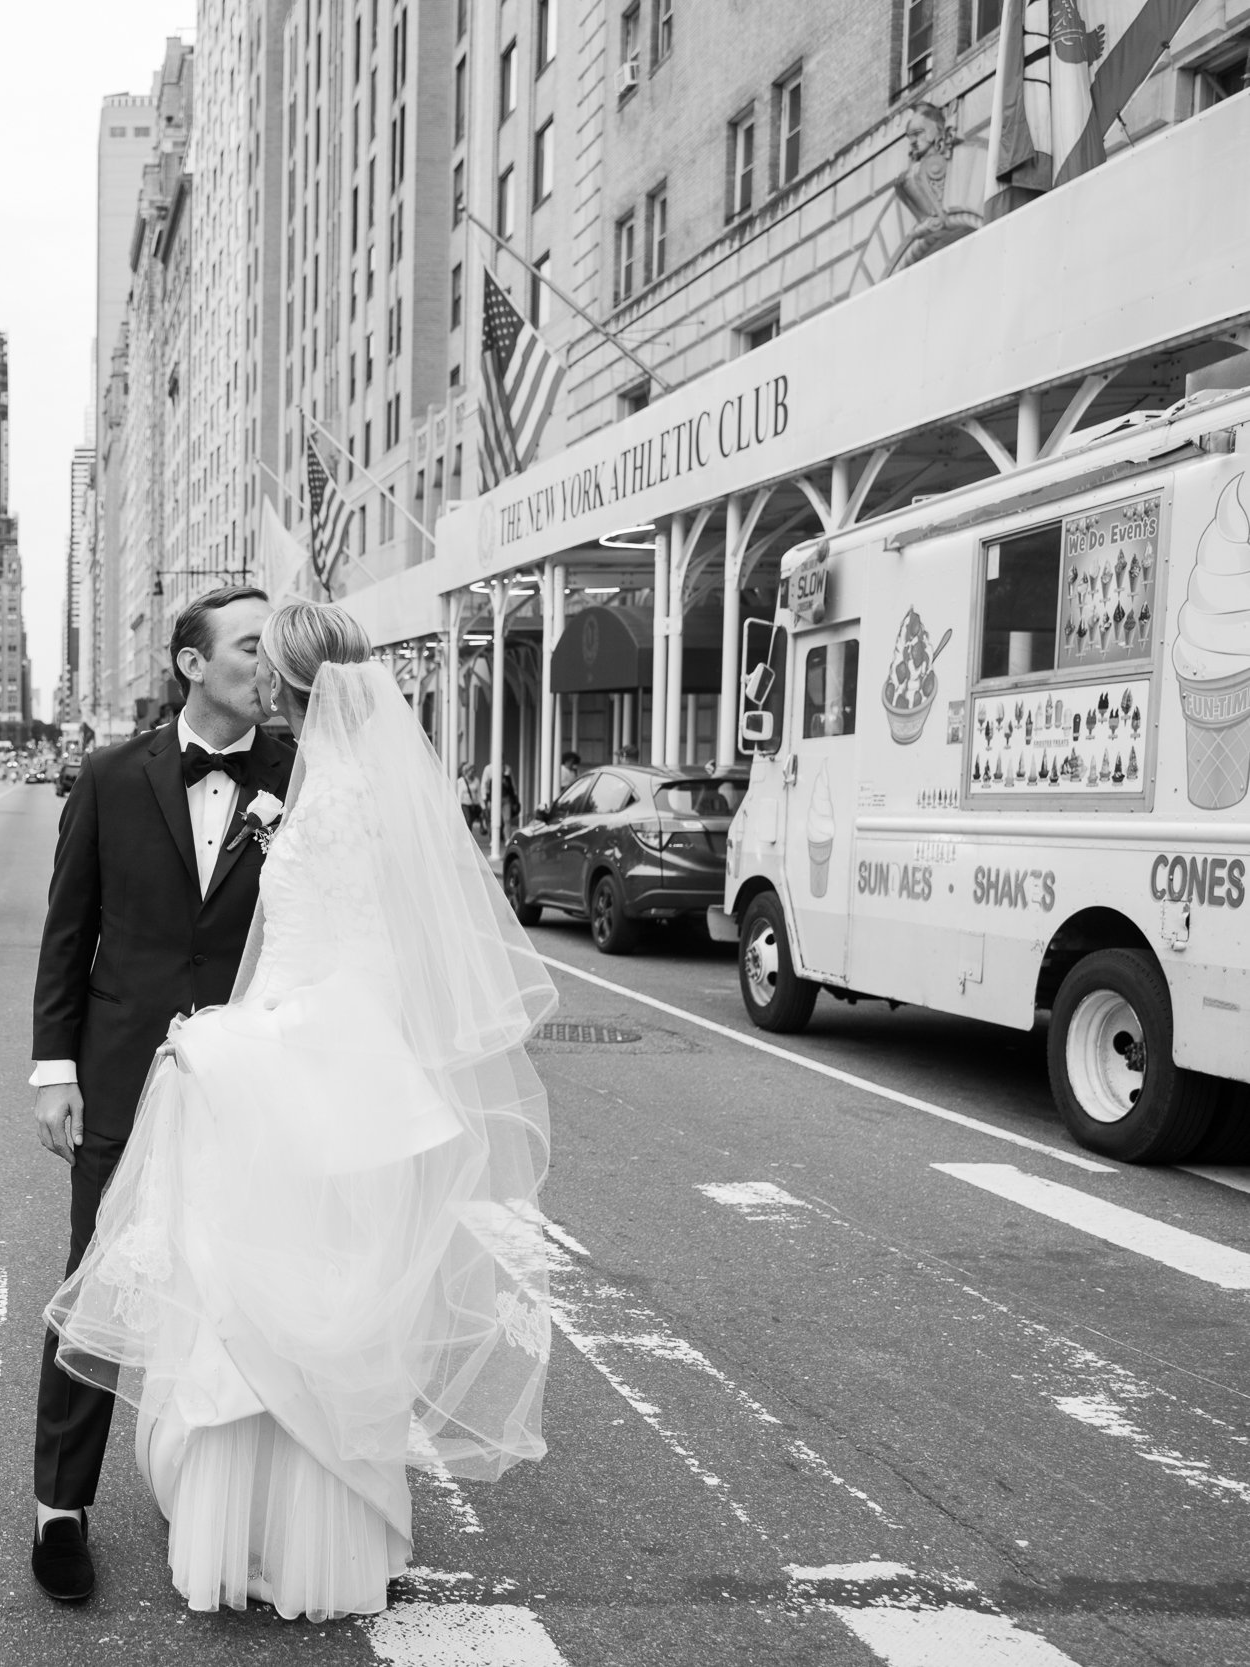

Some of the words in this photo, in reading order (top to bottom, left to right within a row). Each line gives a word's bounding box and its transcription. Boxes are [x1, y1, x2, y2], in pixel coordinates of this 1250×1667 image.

[501, 500, 523, 546] THE
[526, 483, 559, 536] NEW
[561, 461, 606, 522] YORK
[608, 411, 711, 504] ATHLETIC
[718, 374, 788, 458] CLUB
[1068, 533, 1086, 557] We
[1088, 529, 1105, 552] Do
[1110, 517, 1158, 545] Events
[797, 568, 826, 600] SLOW
[858, 860, 932, 901] SUNAES
[1151, 854, 1245, 909] CONES
